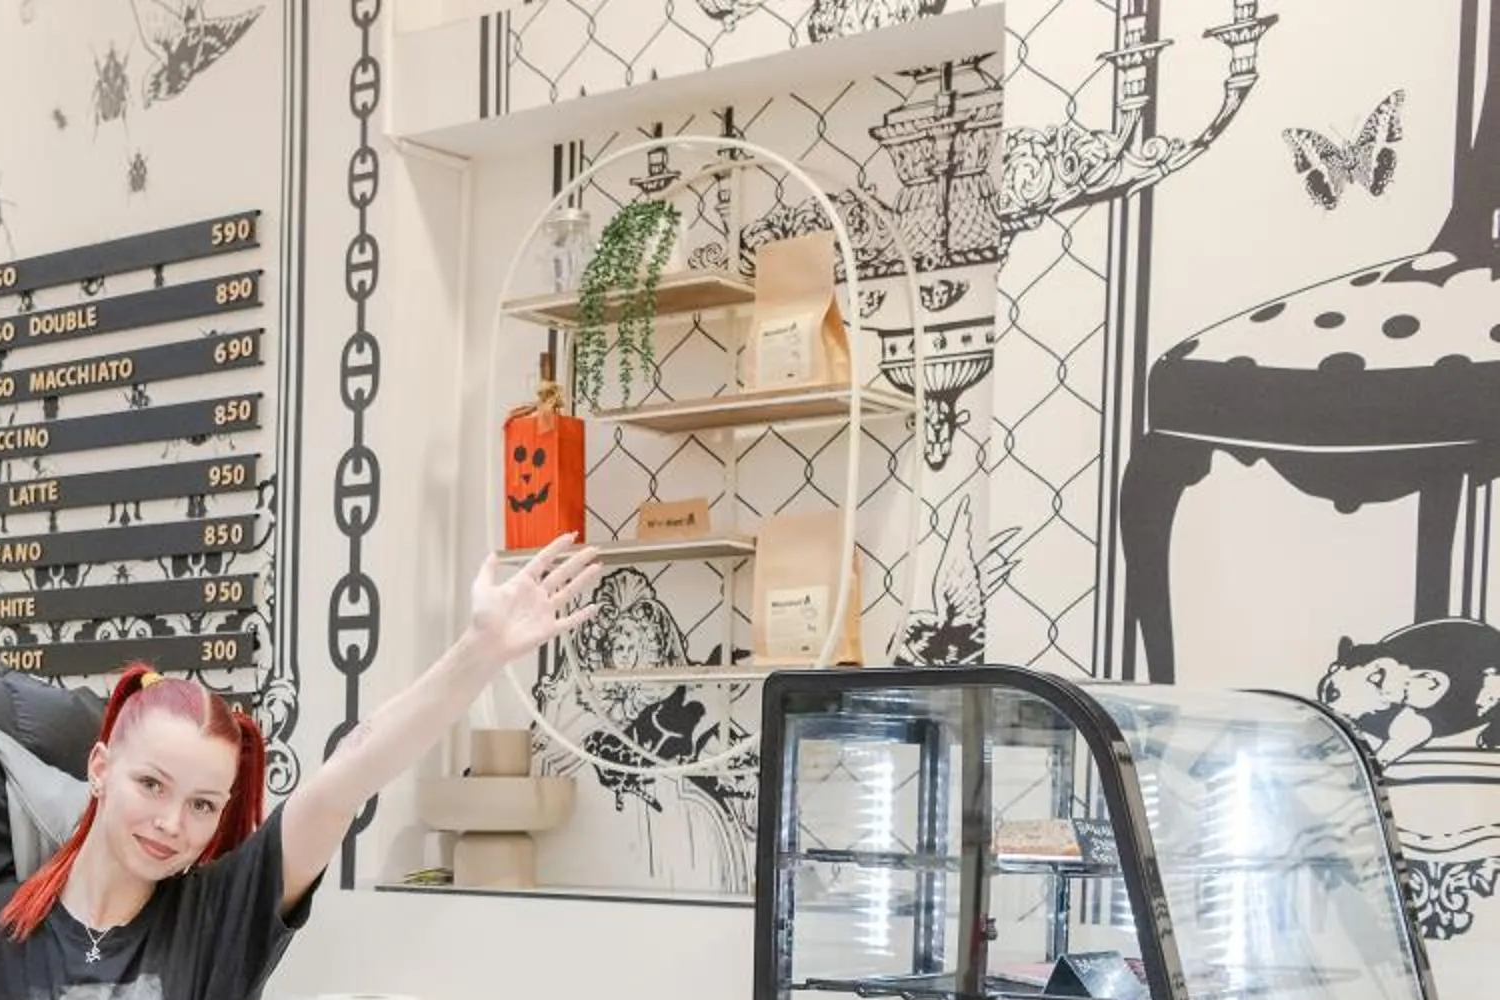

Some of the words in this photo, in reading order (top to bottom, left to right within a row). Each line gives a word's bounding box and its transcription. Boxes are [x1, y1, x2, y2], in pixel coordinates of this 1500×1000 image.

[211, 218, 250, 246] 590
[29, 307, 98, 337] DOUBLE
[215, 277, 253, 304] 890
[29, 358, 133, 392] MACCHIATO
[213, 336, 253, 364] 690
[214, 401, 250, 425] 850
[8, 481, 59, 507] LATTE
[208, 464, 245, 487] 950
[204, 524, 243, 545] 850
[204, 581, 243, 602] 950
[0, 650, 43, 670] SHOT
[201, 640, 237, 661] 300
